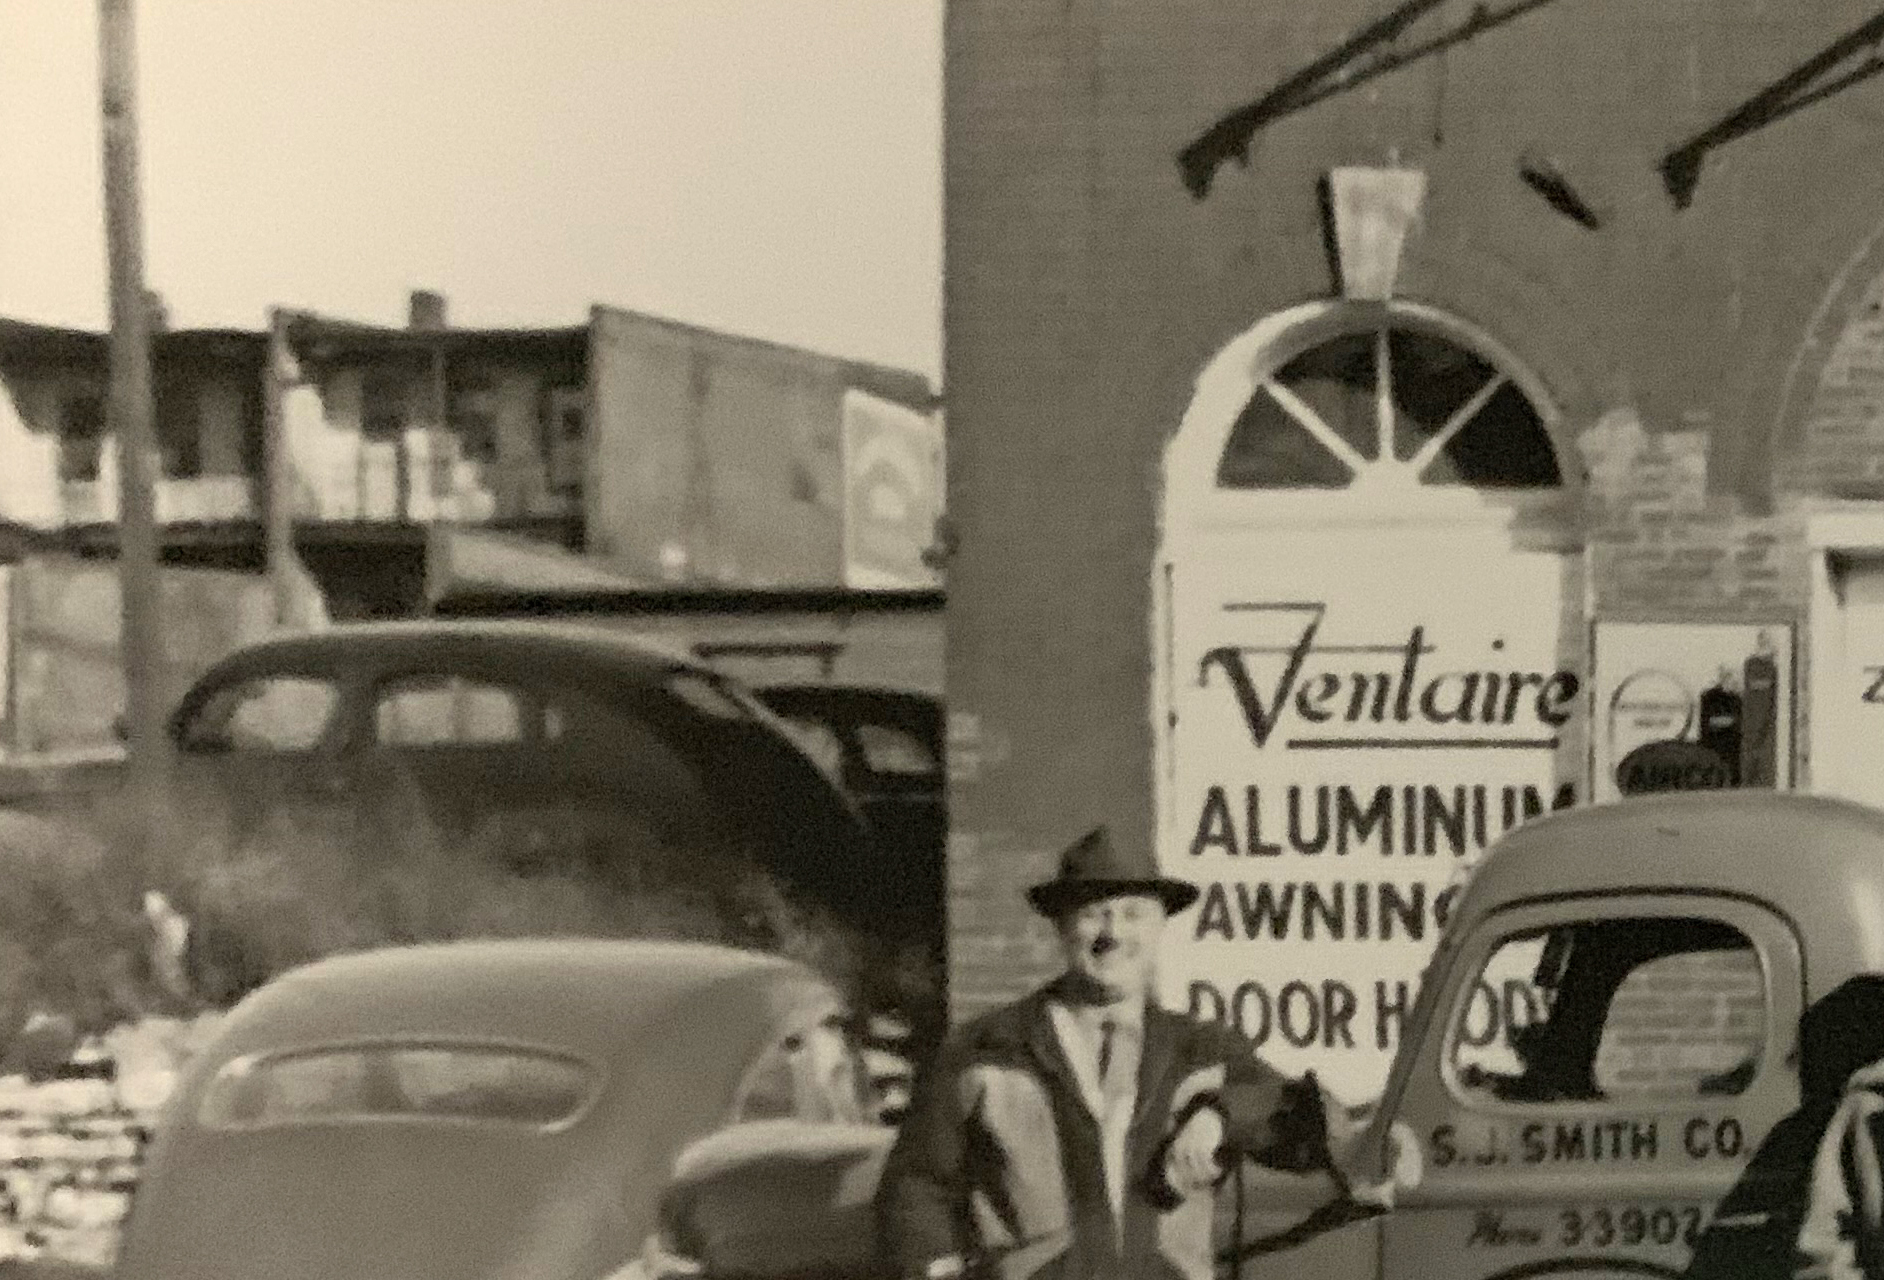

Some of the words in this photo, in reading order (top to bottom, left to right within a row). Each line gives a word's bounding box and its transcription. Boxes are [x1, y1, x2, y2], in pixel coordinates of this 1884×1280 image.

[1199, 602, 1580, 748] Ventaire
[1189, 978, 1357, 1049] DOOR
[1521, 1117, 1657, 1163] SMITH
